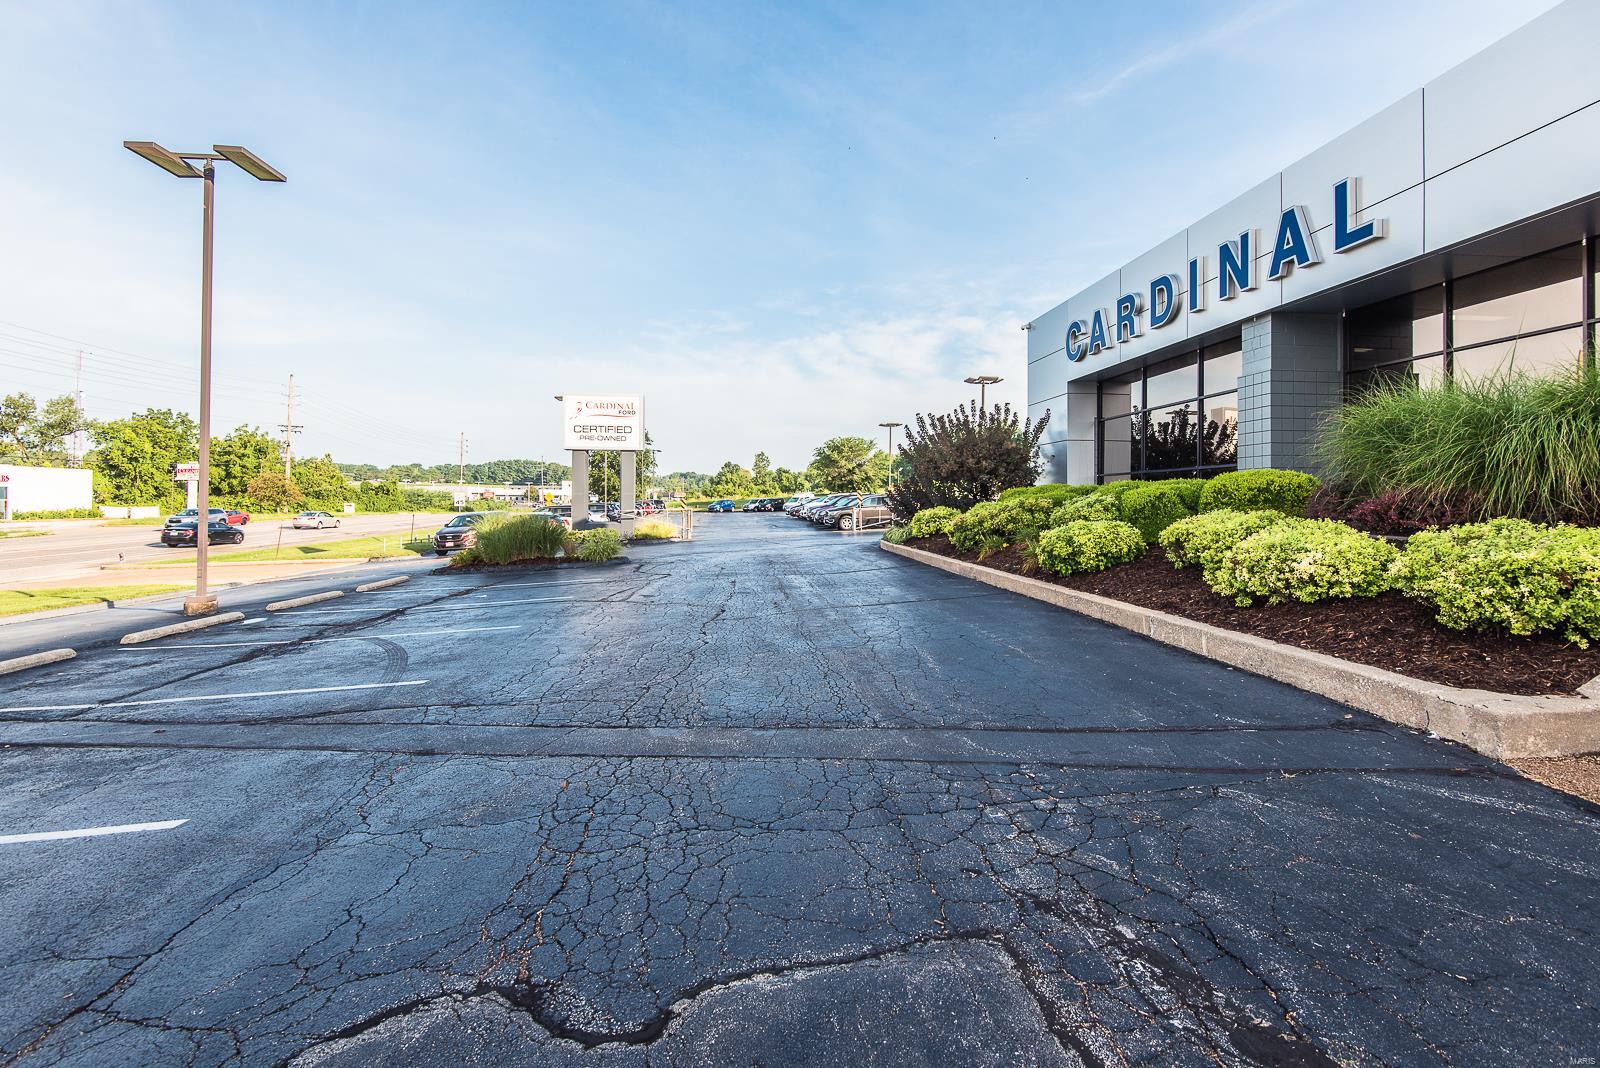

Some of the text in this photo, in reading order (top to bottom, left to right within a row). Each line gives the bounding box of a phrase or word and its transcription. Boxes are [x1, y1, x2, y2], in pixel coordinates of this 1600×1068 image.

[1064, 177, 1384, 363] CARDINAL
[585, 400, 634, 410] CARDINAL
[573, 425, 633, 434] CERTIFIED
